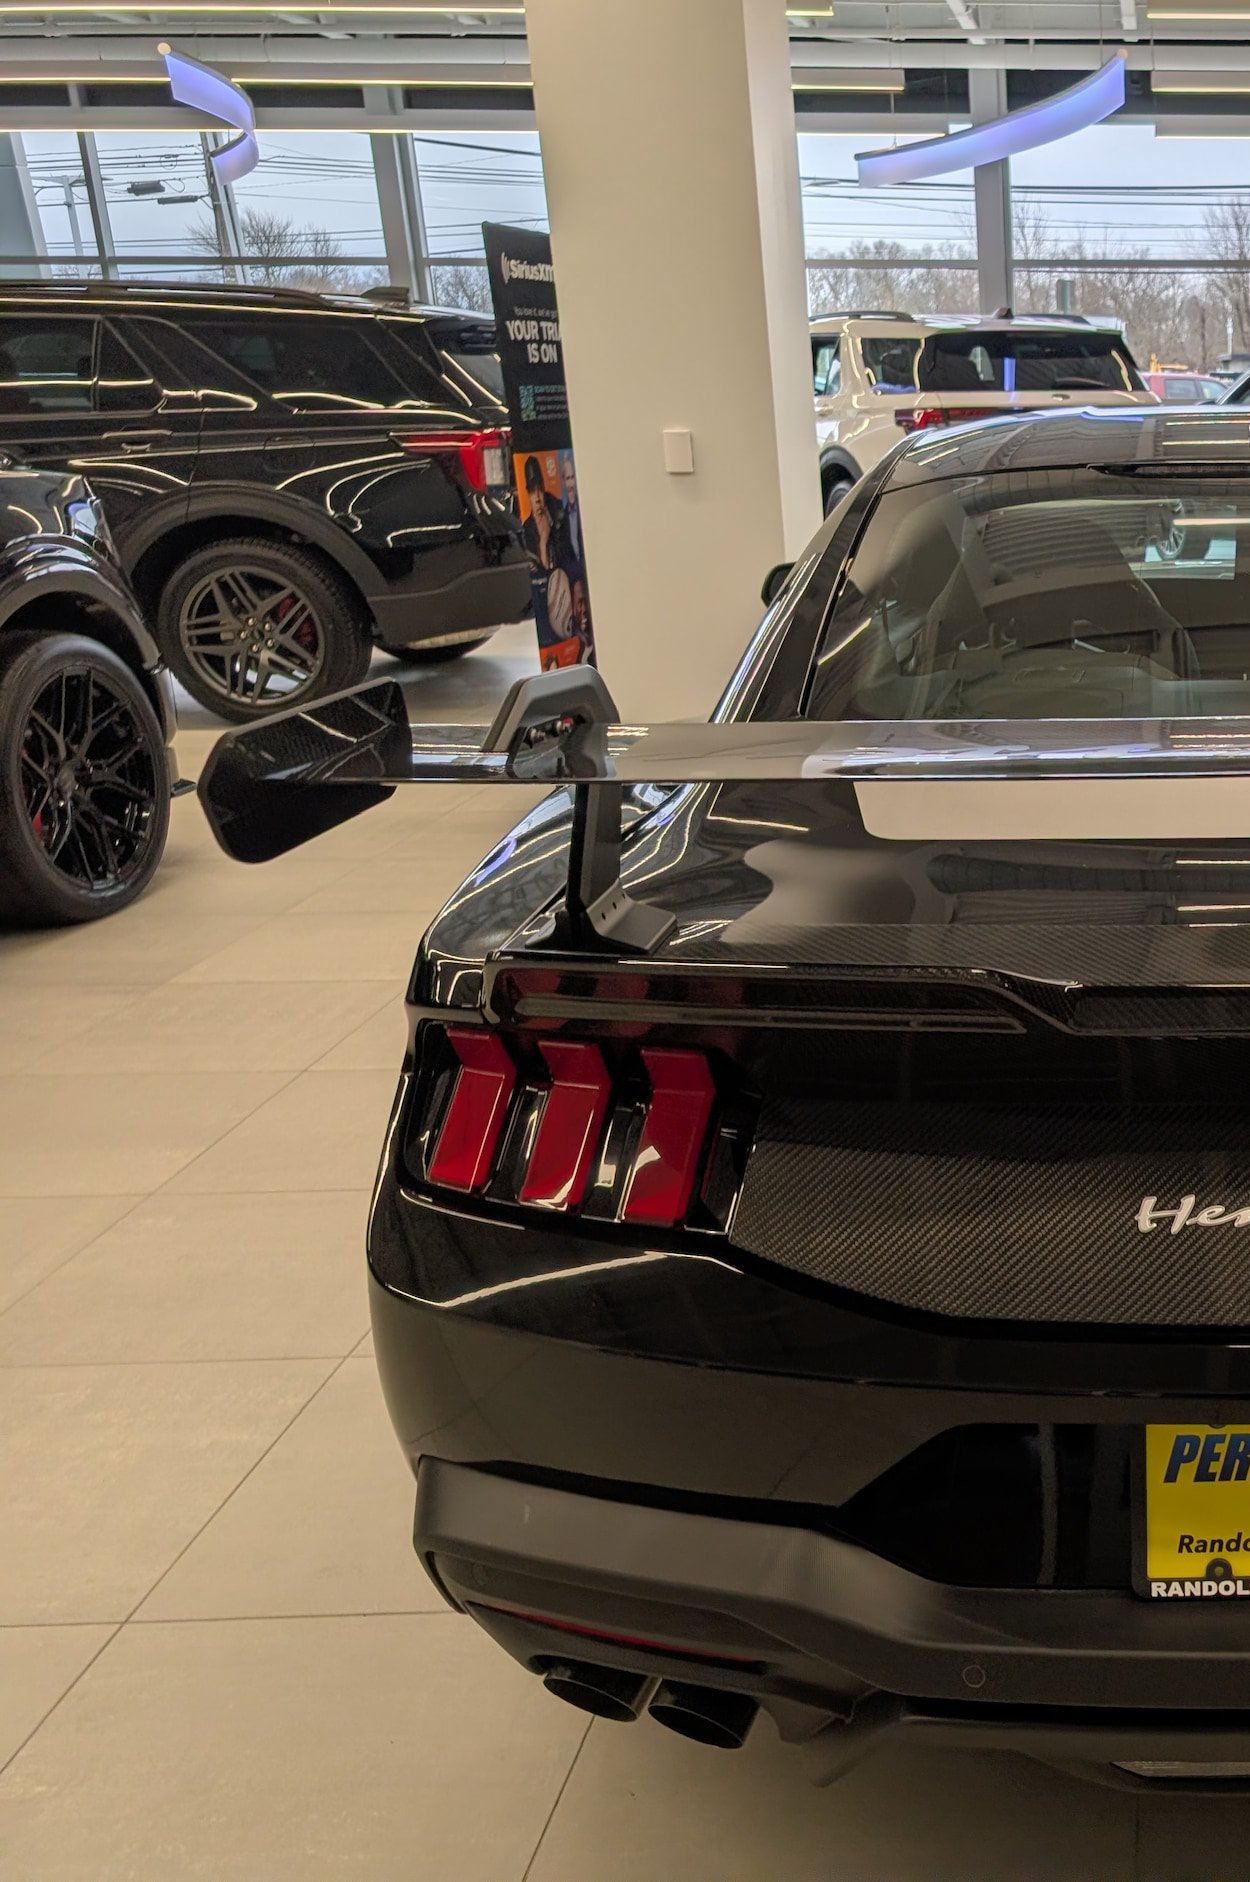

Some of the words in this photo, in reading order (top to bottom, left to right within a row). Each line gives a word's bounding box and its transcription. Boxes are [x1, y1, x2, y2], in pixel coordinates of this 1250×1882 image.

[506, 320, 539, 341] YOUR
[527, 343, 540, 363] IS
[541, 343, 558, 363] ON
